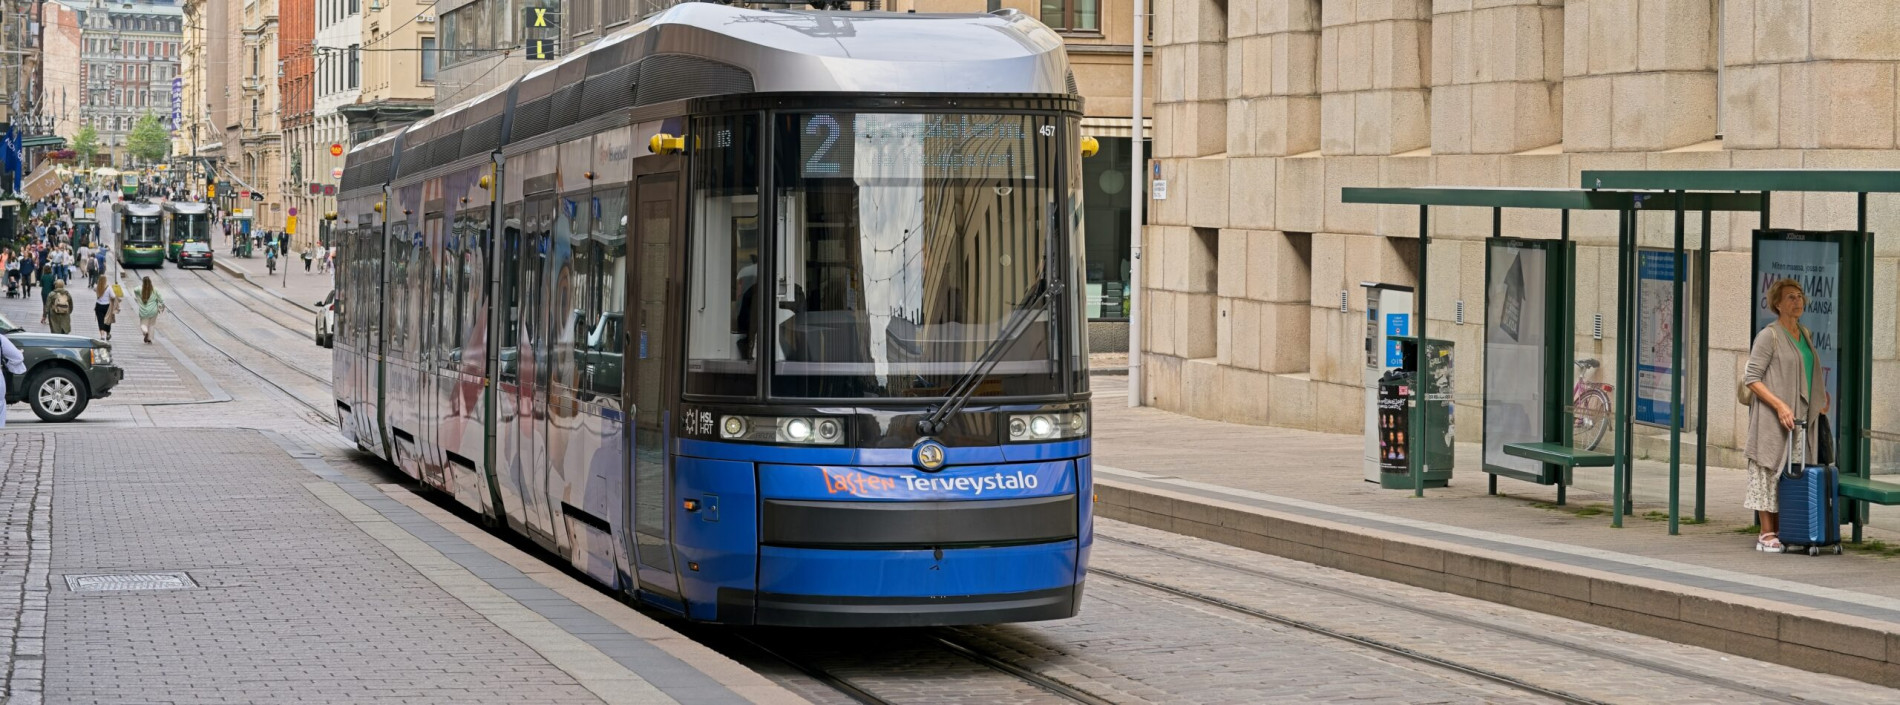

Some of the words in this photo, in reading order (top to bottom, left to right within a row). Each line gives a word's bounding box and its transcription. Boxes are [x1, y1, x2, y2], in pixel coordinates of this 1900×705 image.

[1039, 124, 1056, 138] 457
[805, 113, 840, 173] 2
[700, 411, 713, 424] HSL
[700, 422, 713, 435] HRT
[900, 470, 1038, 495] Terveystalo
